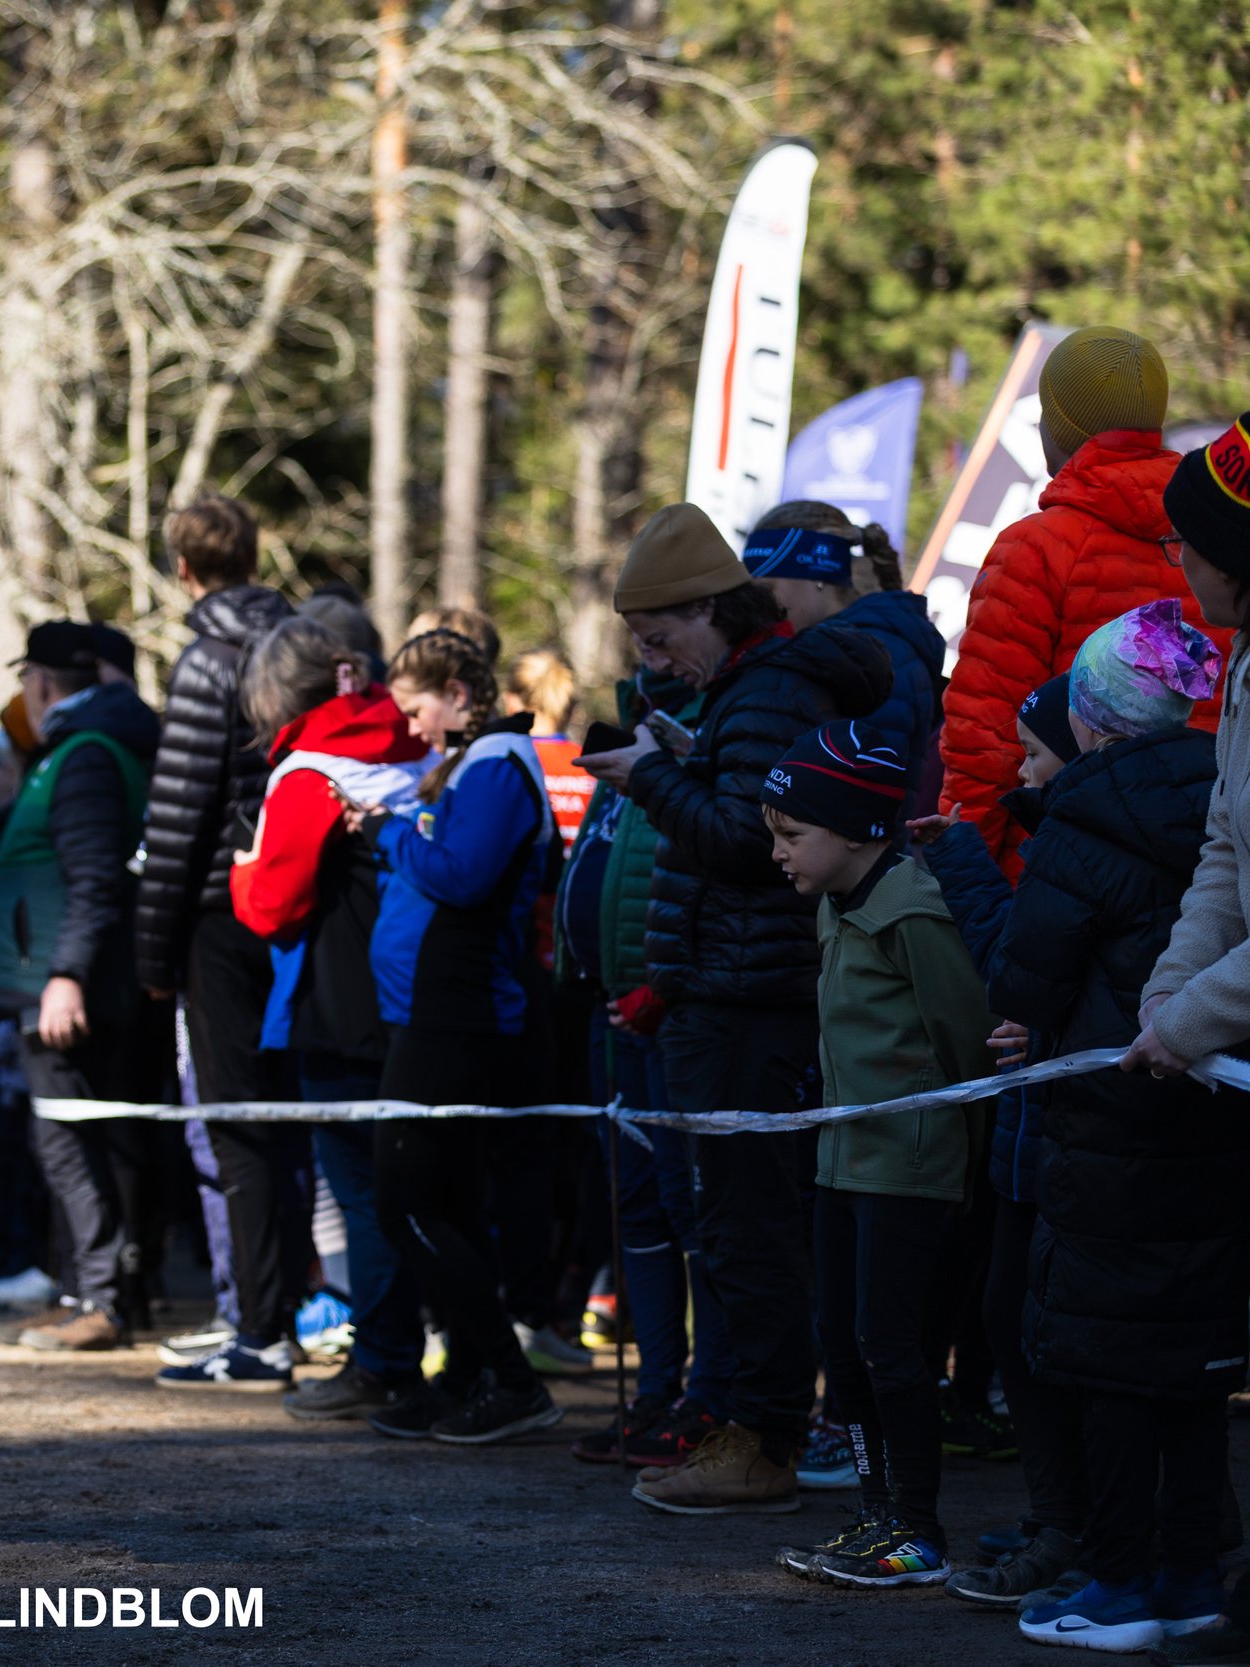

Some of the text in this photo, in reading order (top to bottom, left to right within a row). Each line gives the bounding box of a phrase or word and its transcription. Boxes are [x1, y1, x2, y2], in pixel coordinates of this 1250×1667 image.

[1026, 690, 1039, 709] DA
[764, 779, 785, 796] RING
[767, 767, 792, 789] NDA
[849, 1423, 871, 1475] noname
